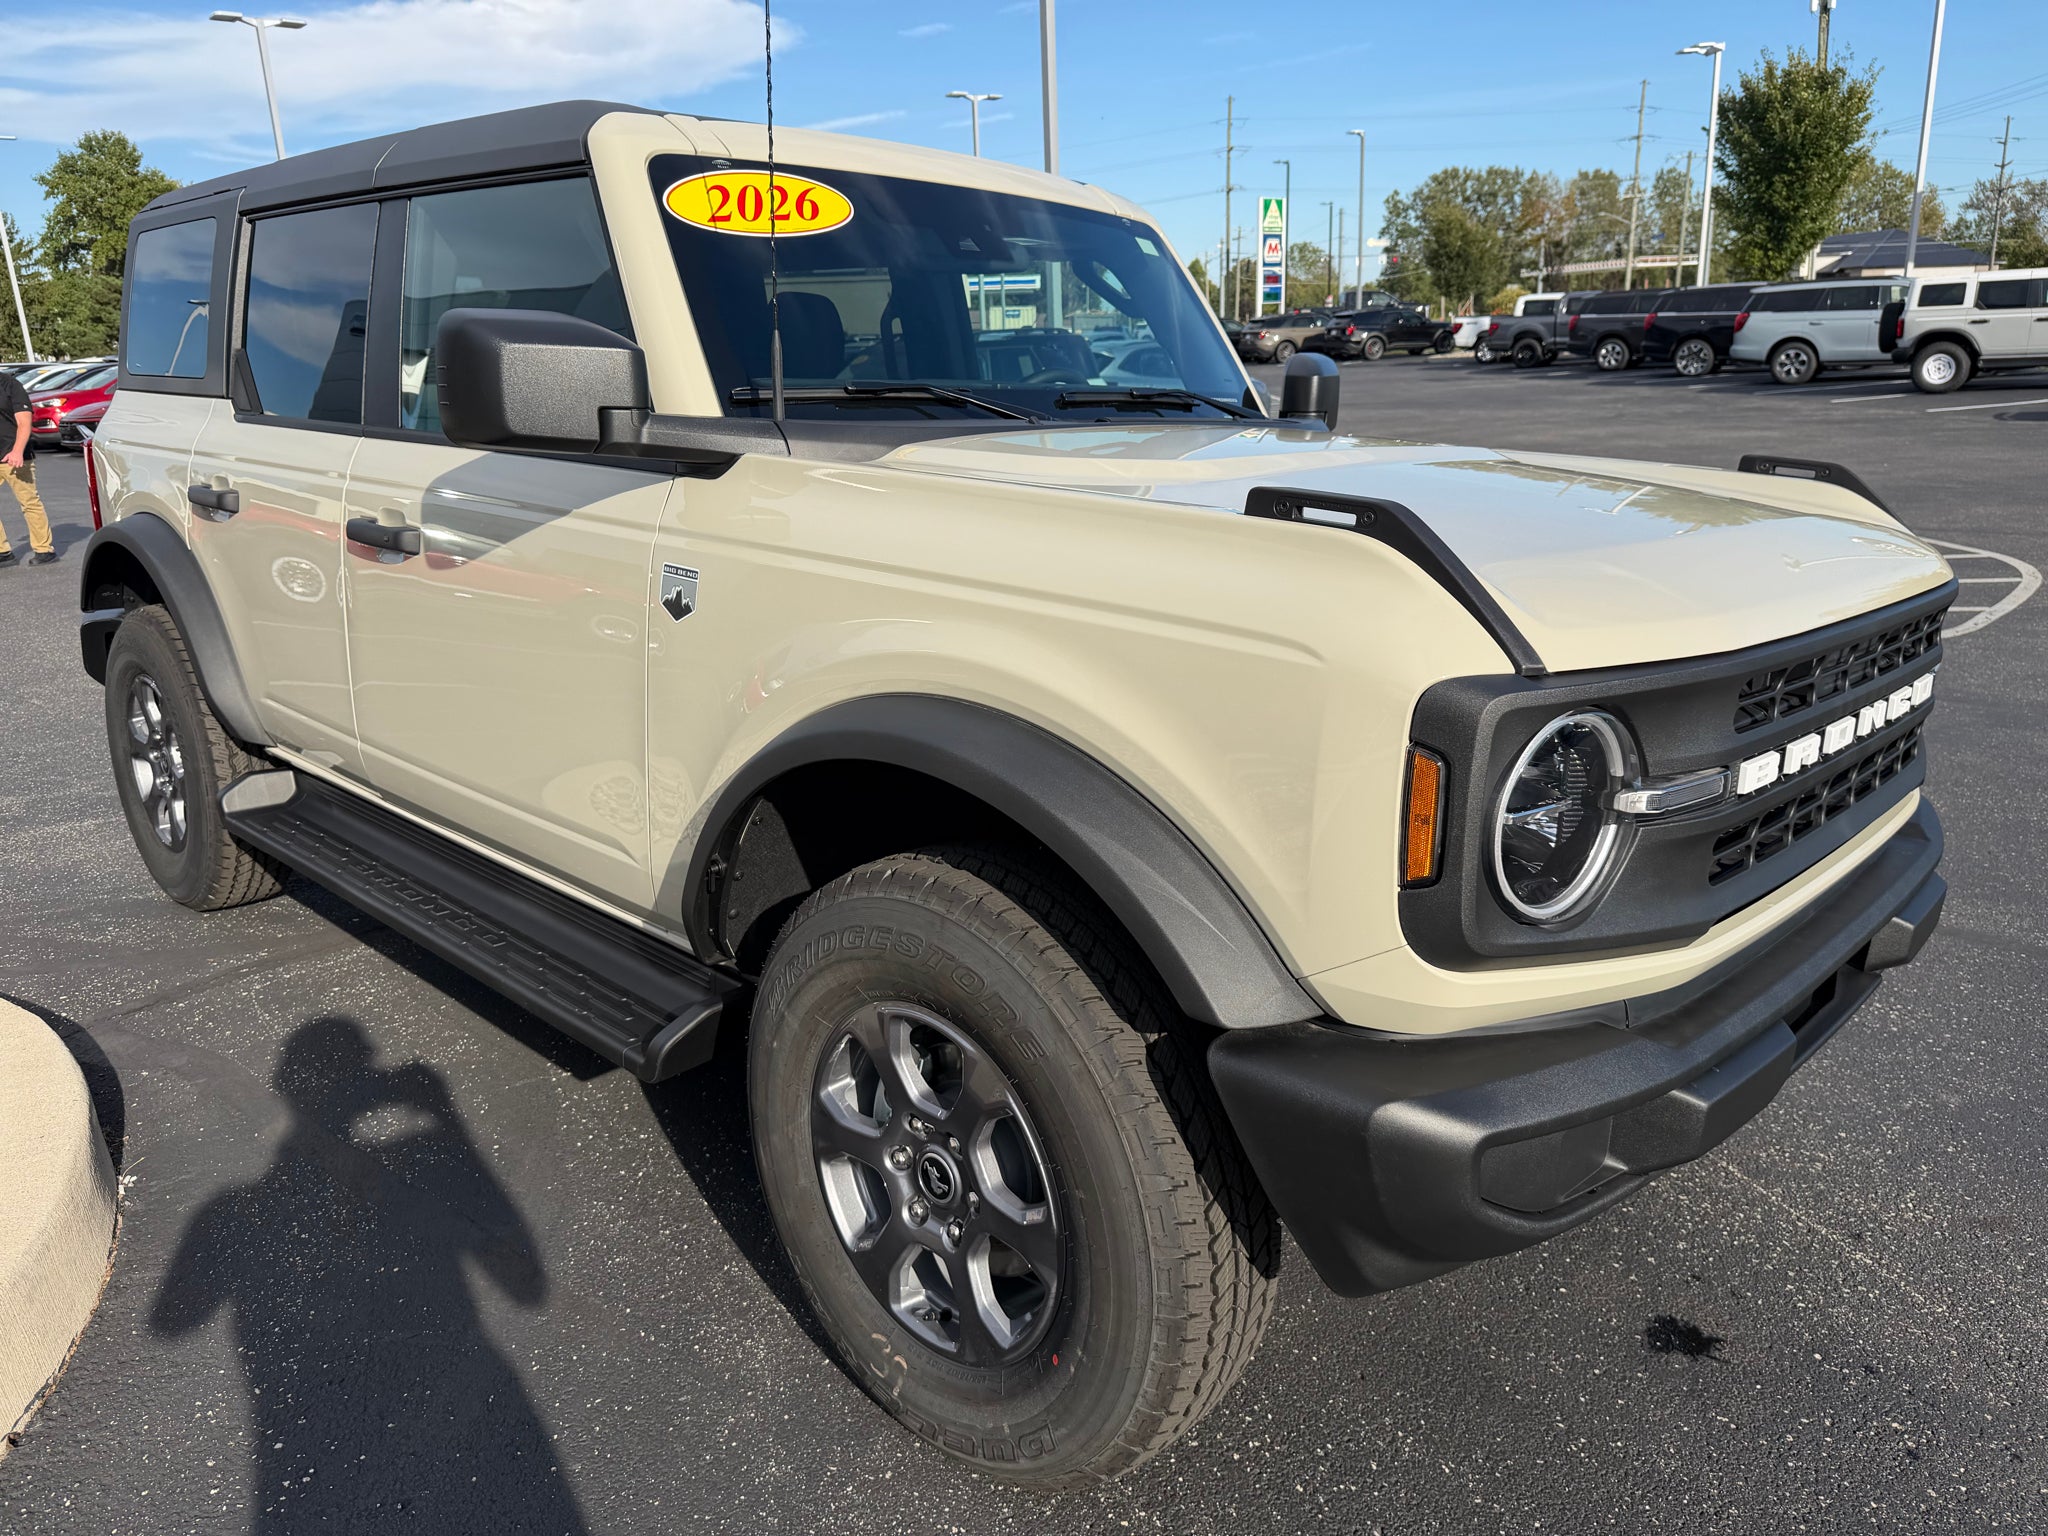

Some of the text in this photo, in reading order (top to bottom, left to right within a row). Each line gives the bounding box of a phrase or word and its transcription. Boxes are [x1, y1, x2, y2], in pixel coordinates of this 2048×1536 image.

[707, 184, 819, 223] 2026
[1267, 242, 1279, 254] M
[664, 566, 698, 578] BIG BEND
[1736, 672, 1934, 796] BRONCO
[767, 925, 1048, 1062] BRIDGESTONE
